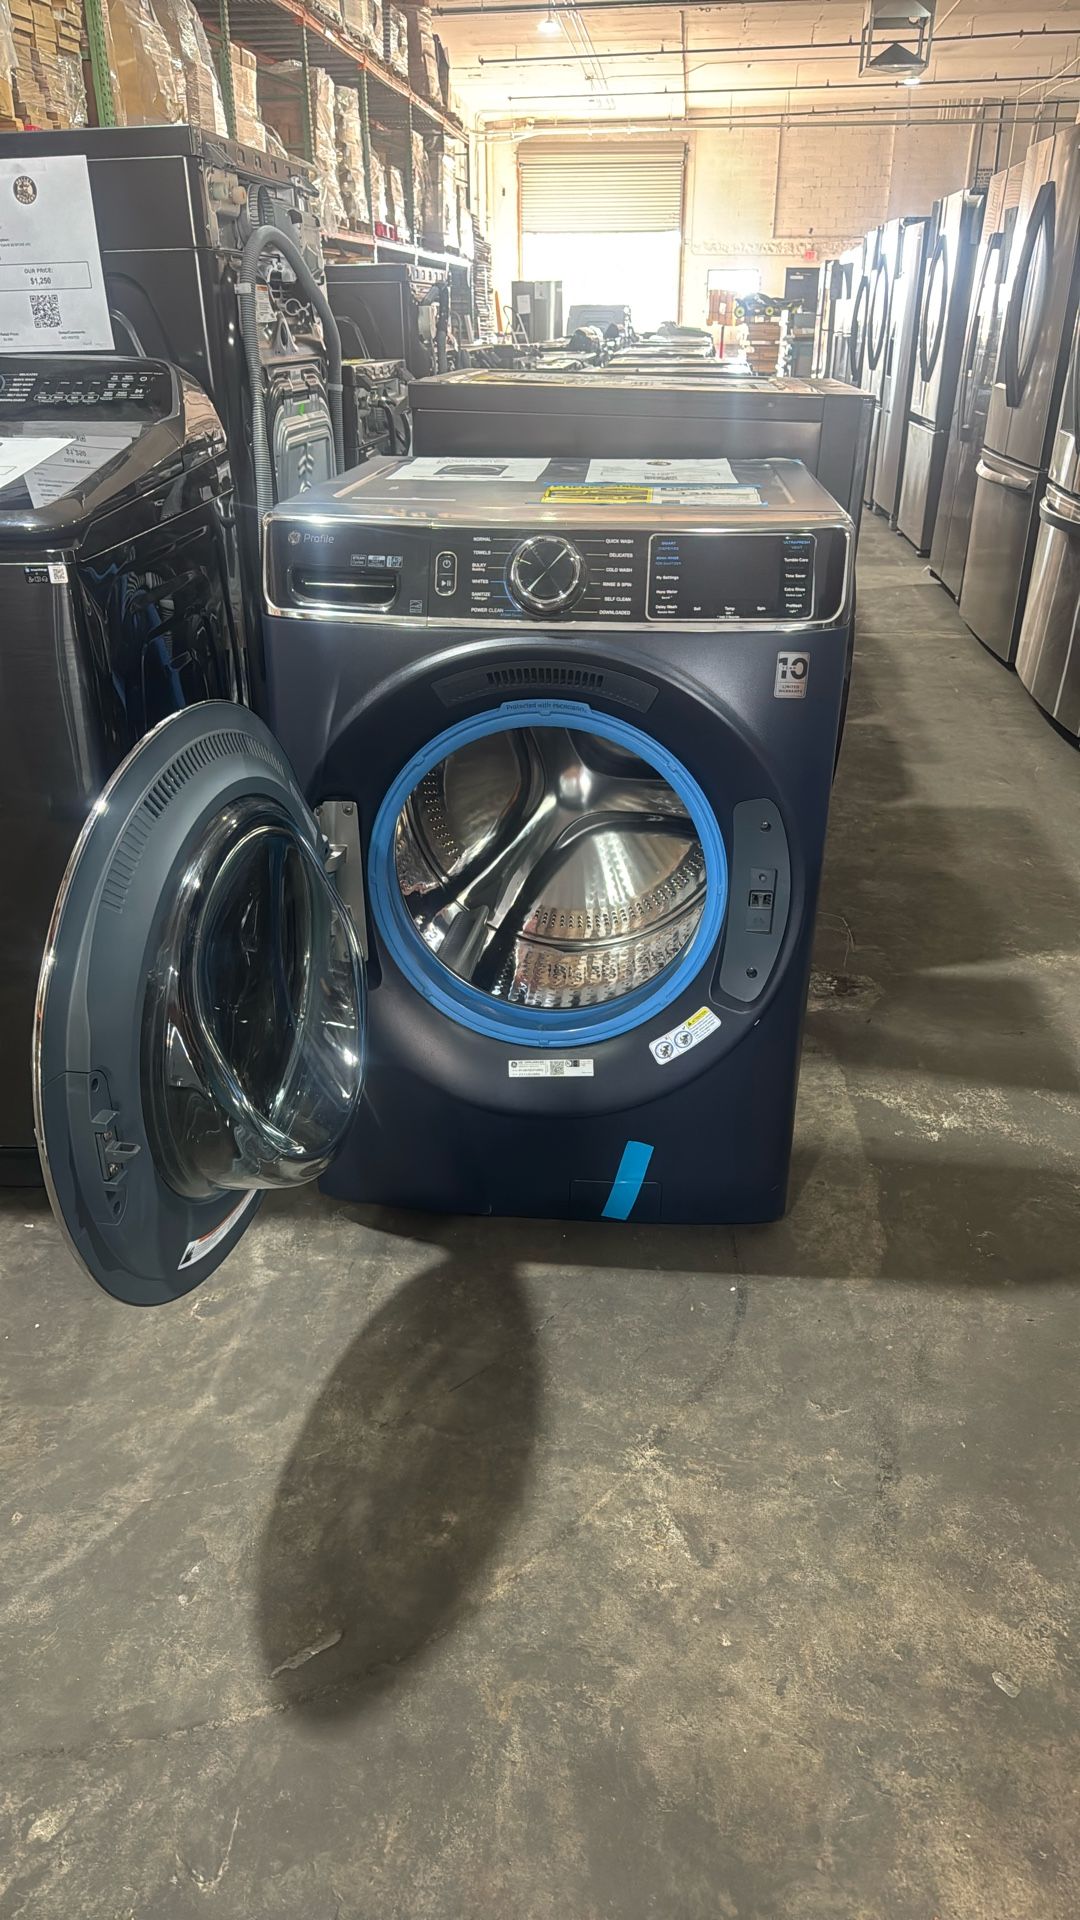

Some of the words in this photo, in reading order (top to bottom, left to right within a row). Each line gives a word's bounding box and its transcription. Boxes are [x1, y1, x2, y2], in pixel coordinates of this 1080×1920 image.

[30, 277, 52, 286] $1,250
[304, 535, 334, 544] Profile
[779, 658, 808, 680] 10
